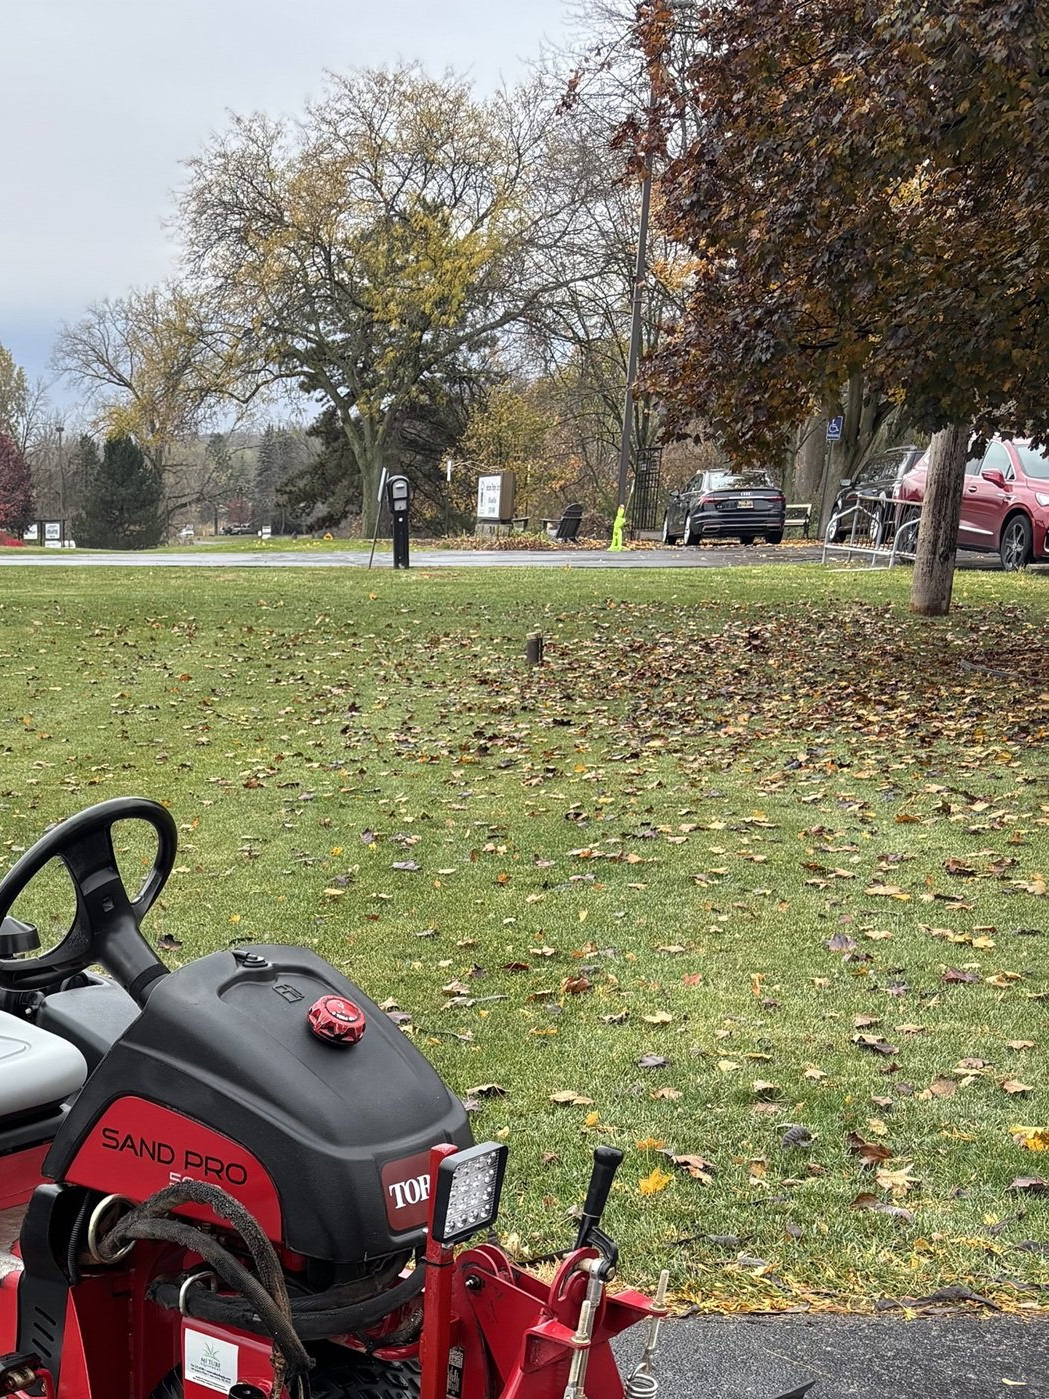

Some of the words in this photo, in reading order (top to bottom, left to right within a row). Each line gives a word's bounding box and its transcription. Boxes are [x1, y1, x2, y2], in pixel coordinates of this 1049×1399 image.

[102, 1127, 175, 1165] SAND
[184, 1150, 248, 1186] PRO
[388, 1174, 431, 1209] TOR
